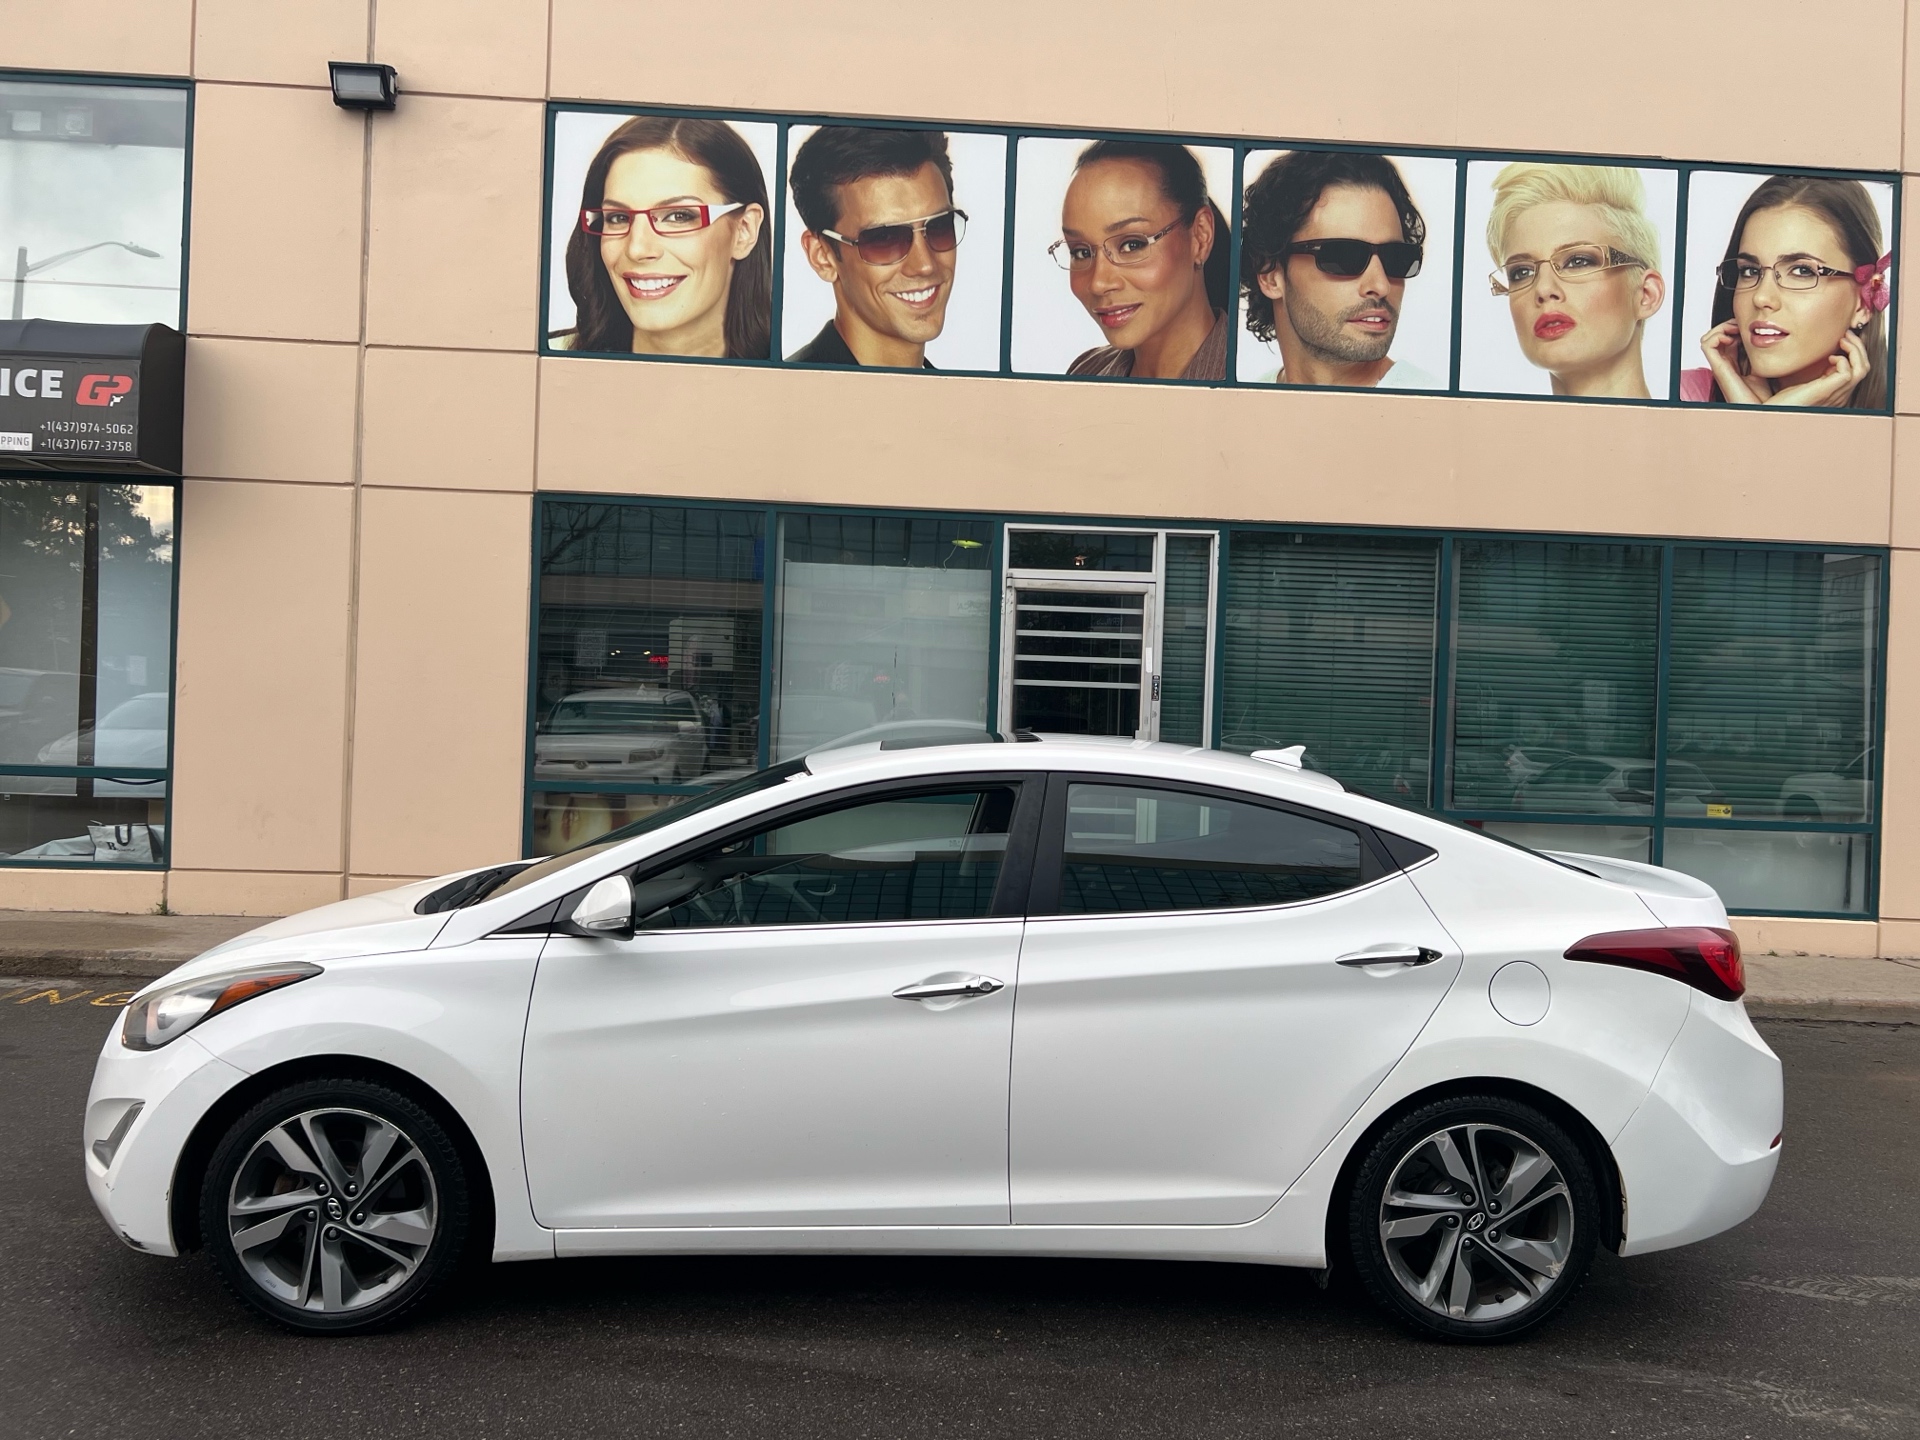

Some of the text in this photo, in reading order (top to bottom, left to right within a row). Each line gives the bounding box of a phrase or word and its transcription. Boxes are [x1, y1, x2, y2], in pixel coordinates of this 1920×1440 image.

[0, 368, 64, 398] ICE
[40, 421, 134, 435] +1(437)974-5062
[0, 435, 30, 447] PPING
[40, 438, 132, 452] +1(437)677-3758
